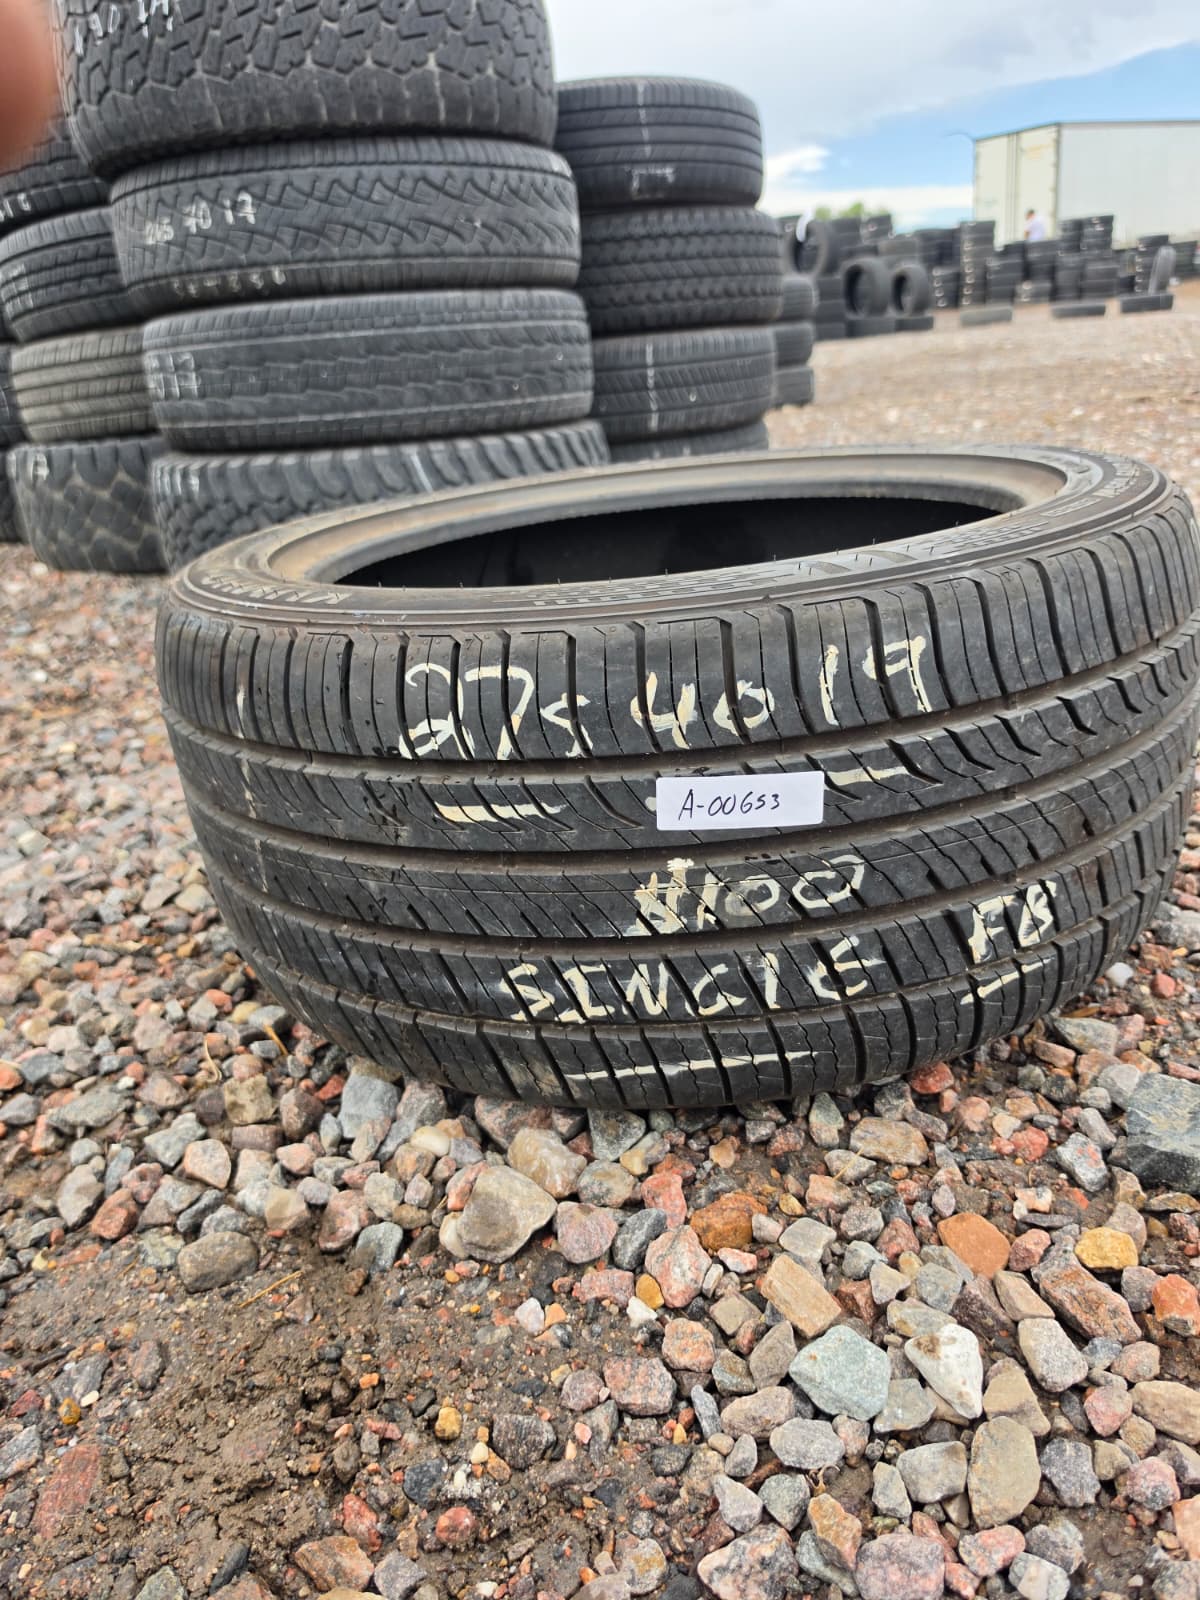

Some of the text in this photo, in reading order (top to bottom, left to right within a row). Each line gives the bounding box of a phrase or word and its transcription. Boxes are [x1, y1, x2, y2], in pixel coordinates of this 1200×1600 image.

[399, 635, 933, 760] 275 40 19
[678, 788, 780, 820] A-00653
